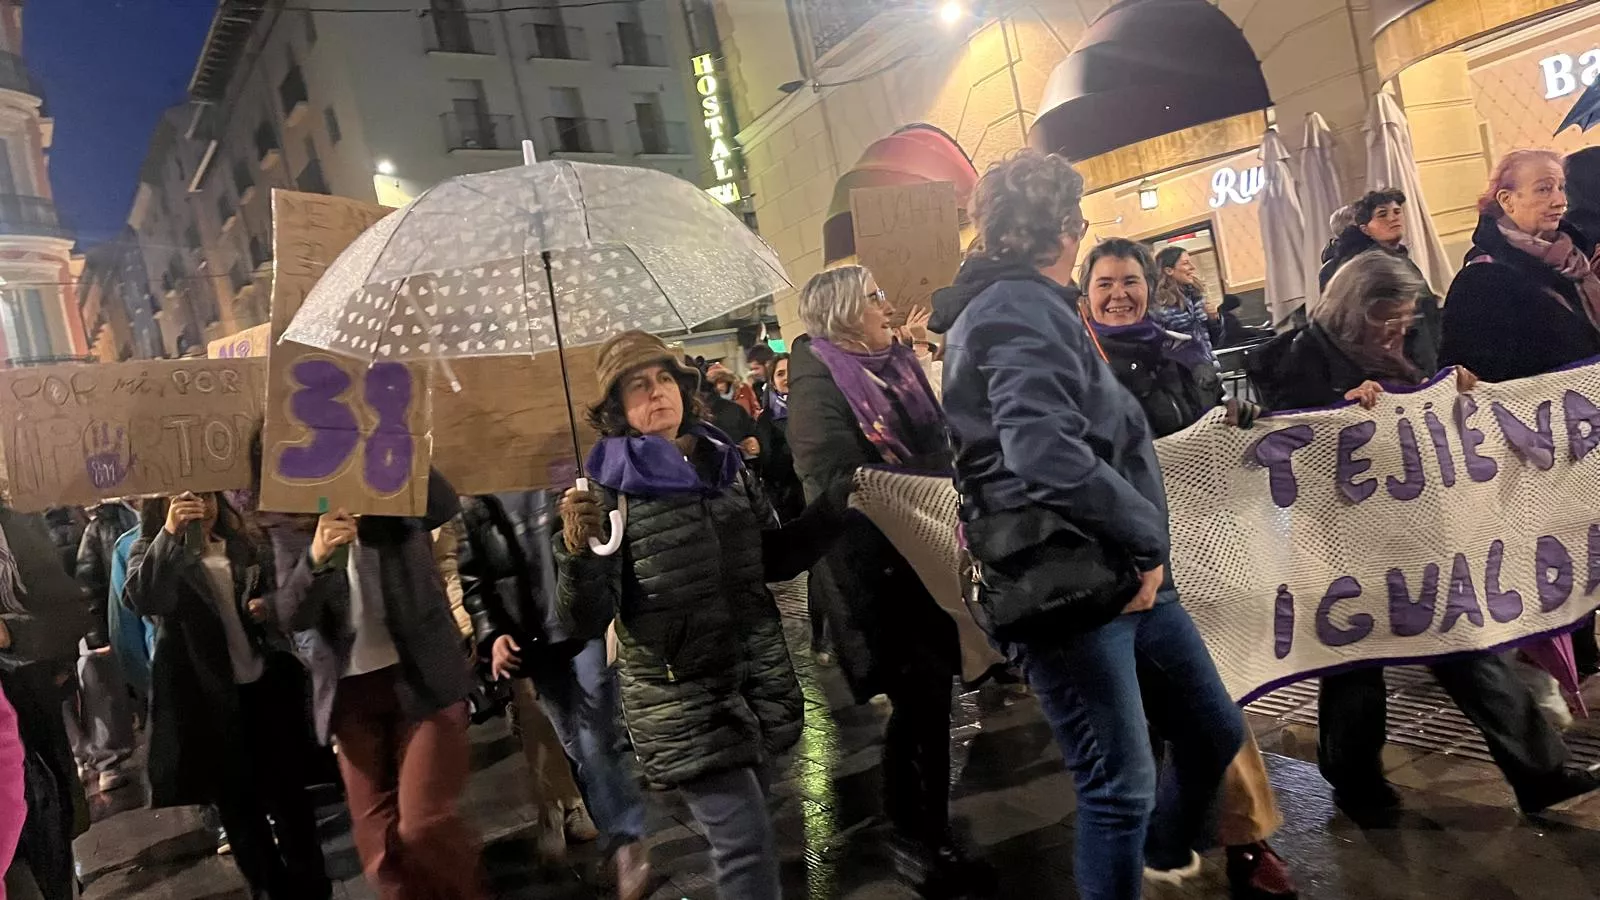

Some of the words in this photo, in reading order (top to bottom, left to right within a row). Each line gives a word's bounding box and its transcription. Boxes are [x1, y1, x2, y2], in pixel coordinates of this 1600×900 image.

[691, 54, 733, 181] HOSTAL
[1209, 167, 1265, 208] Ru
[11, 371, 98, 406] POR
[172, 368, 241, 394] POR
